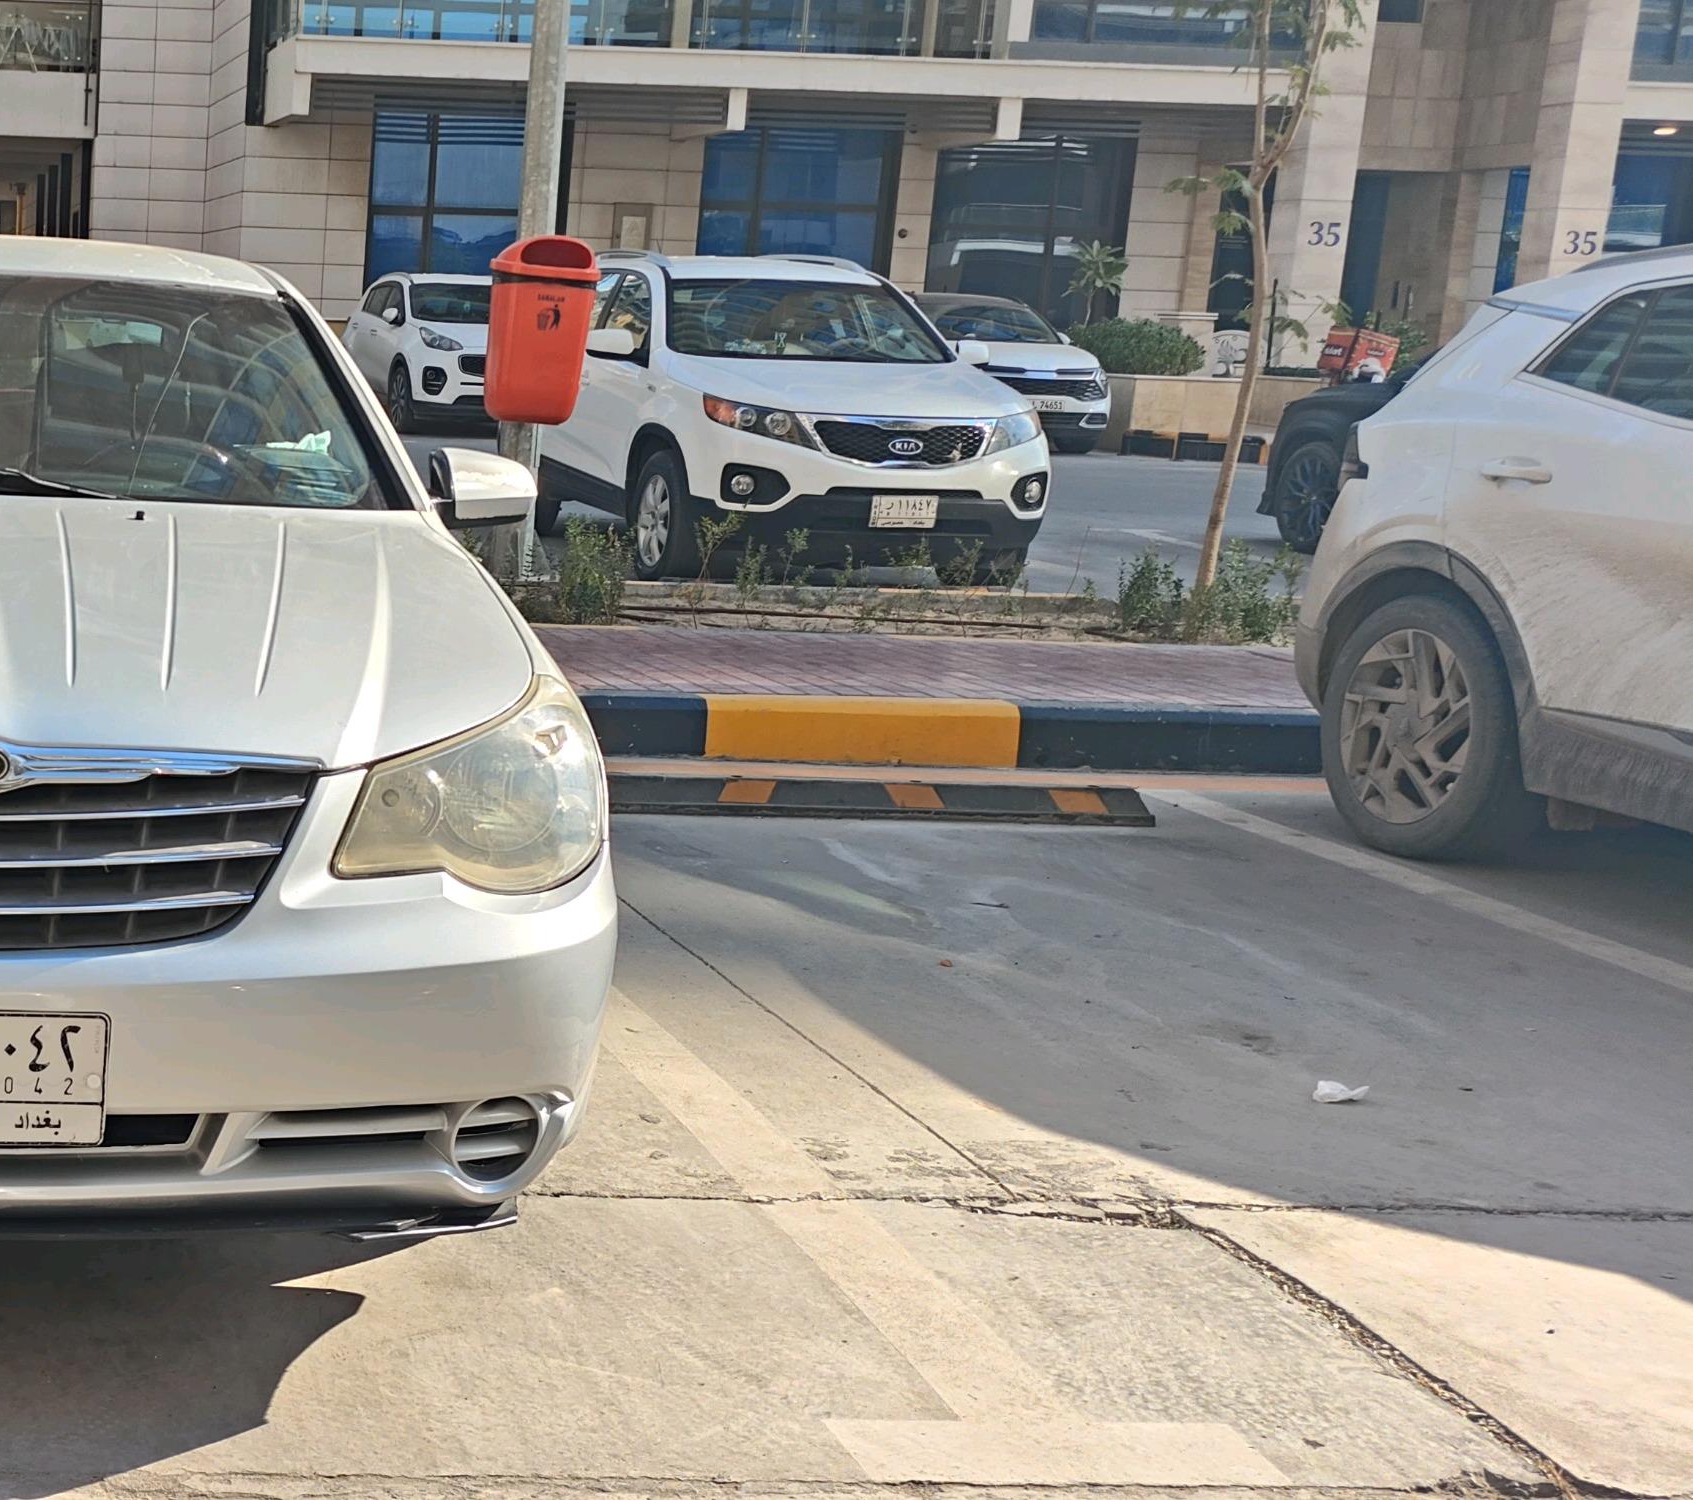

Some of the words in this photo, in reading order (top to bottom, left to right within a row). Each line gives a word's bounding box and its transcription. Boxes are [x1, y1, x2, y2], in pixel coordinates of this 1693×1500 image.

[1307, 221, 1342, 247] 35
[1563, 230, 1598, 256] 35
[1040, 401, 1062, 409] 74651
[895, 442, 916, 451] KIA
[14, 1110, 62, 1136] بغداد
